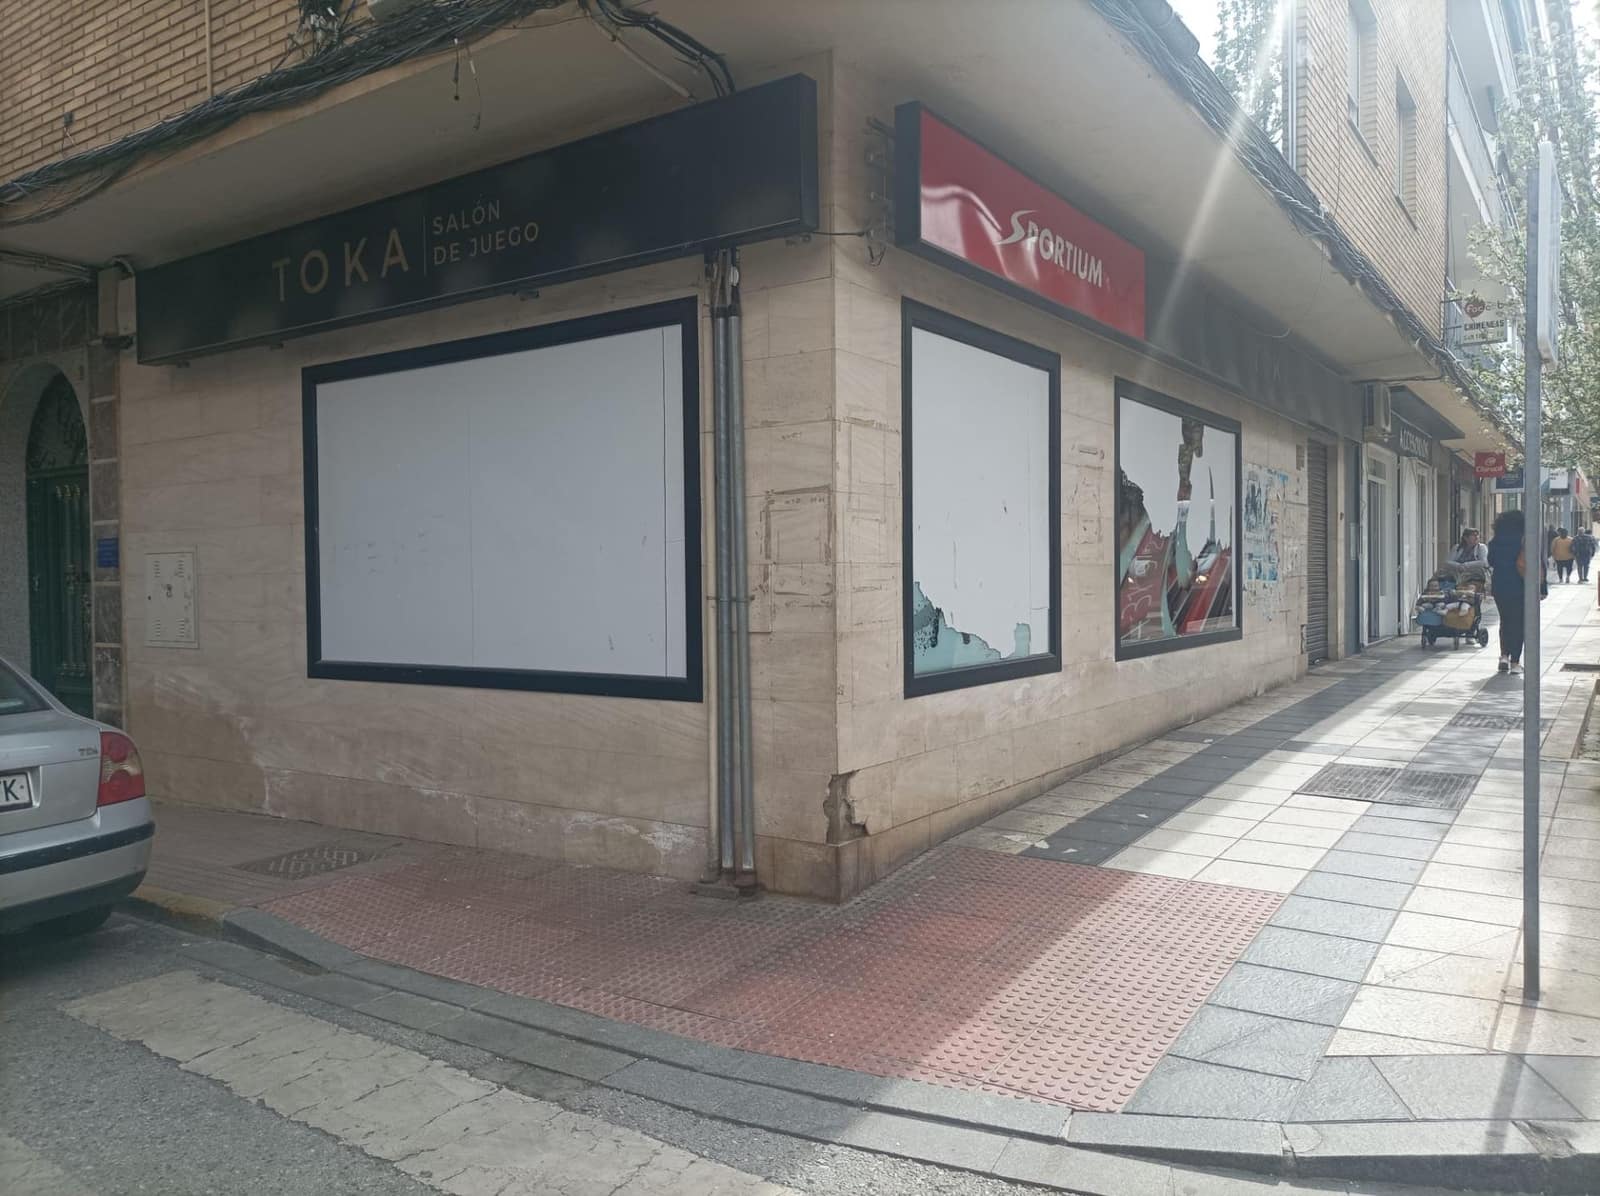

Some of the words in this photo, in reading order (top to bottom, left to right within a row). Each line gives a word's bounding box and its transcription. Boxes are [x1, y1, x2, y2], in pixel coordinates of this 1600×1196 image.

[432, 194, 500, 235] SALÓN
[271, 227, 409, 303] TOKA
[433, 242, 461, 266] DE
[469, 222, 540, 258] JUEGO
[993, 209, 1102, 288] SPORTIUM
[0, 778, 20, 802] K
